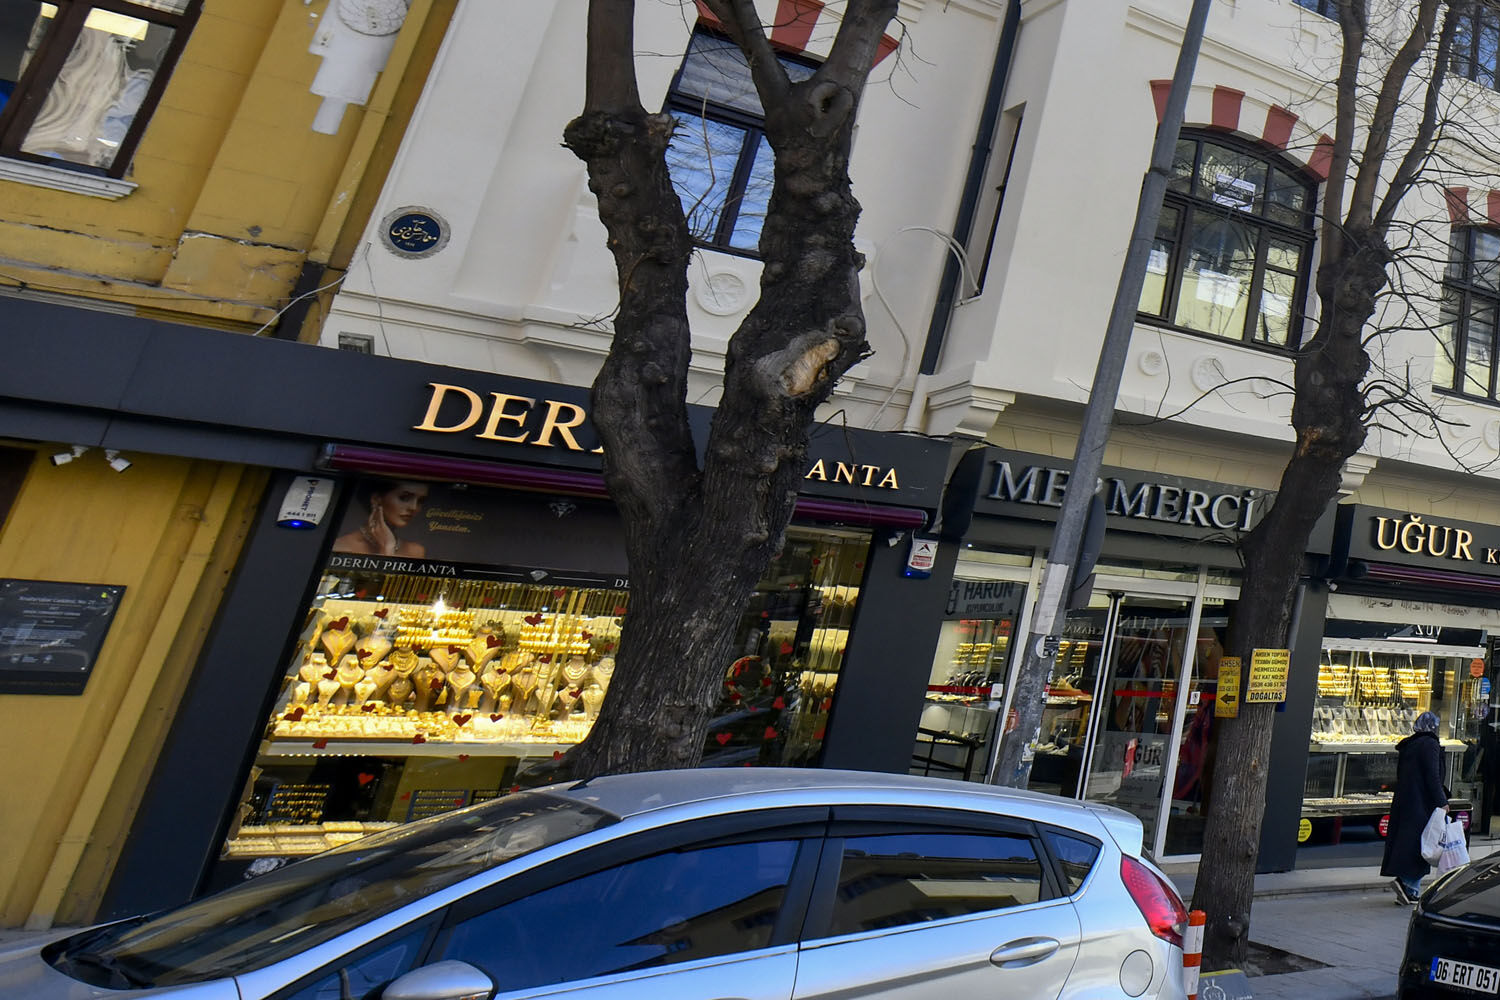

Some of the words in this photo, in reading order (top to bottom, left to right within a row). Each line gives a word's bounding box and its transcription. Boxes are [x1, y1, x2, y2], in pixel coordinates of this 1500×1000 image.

[413, 383, 604, 454] DER
[805, 459, 899, 489] ANTA
[988, 461, 1255, 532] MEMERCİ
[1376, 514, 1474, 561] UĞUR
[330, 556, 379, 570] DERİN
[382, 561, 457, 576] PIRLANTA
[963, 582, 1015, 600] HARUN
[1436, 960, 1449, 981] 06
[1453, 964, 1474, 986] ERT
[1476, 968, 1497, 991] 051
